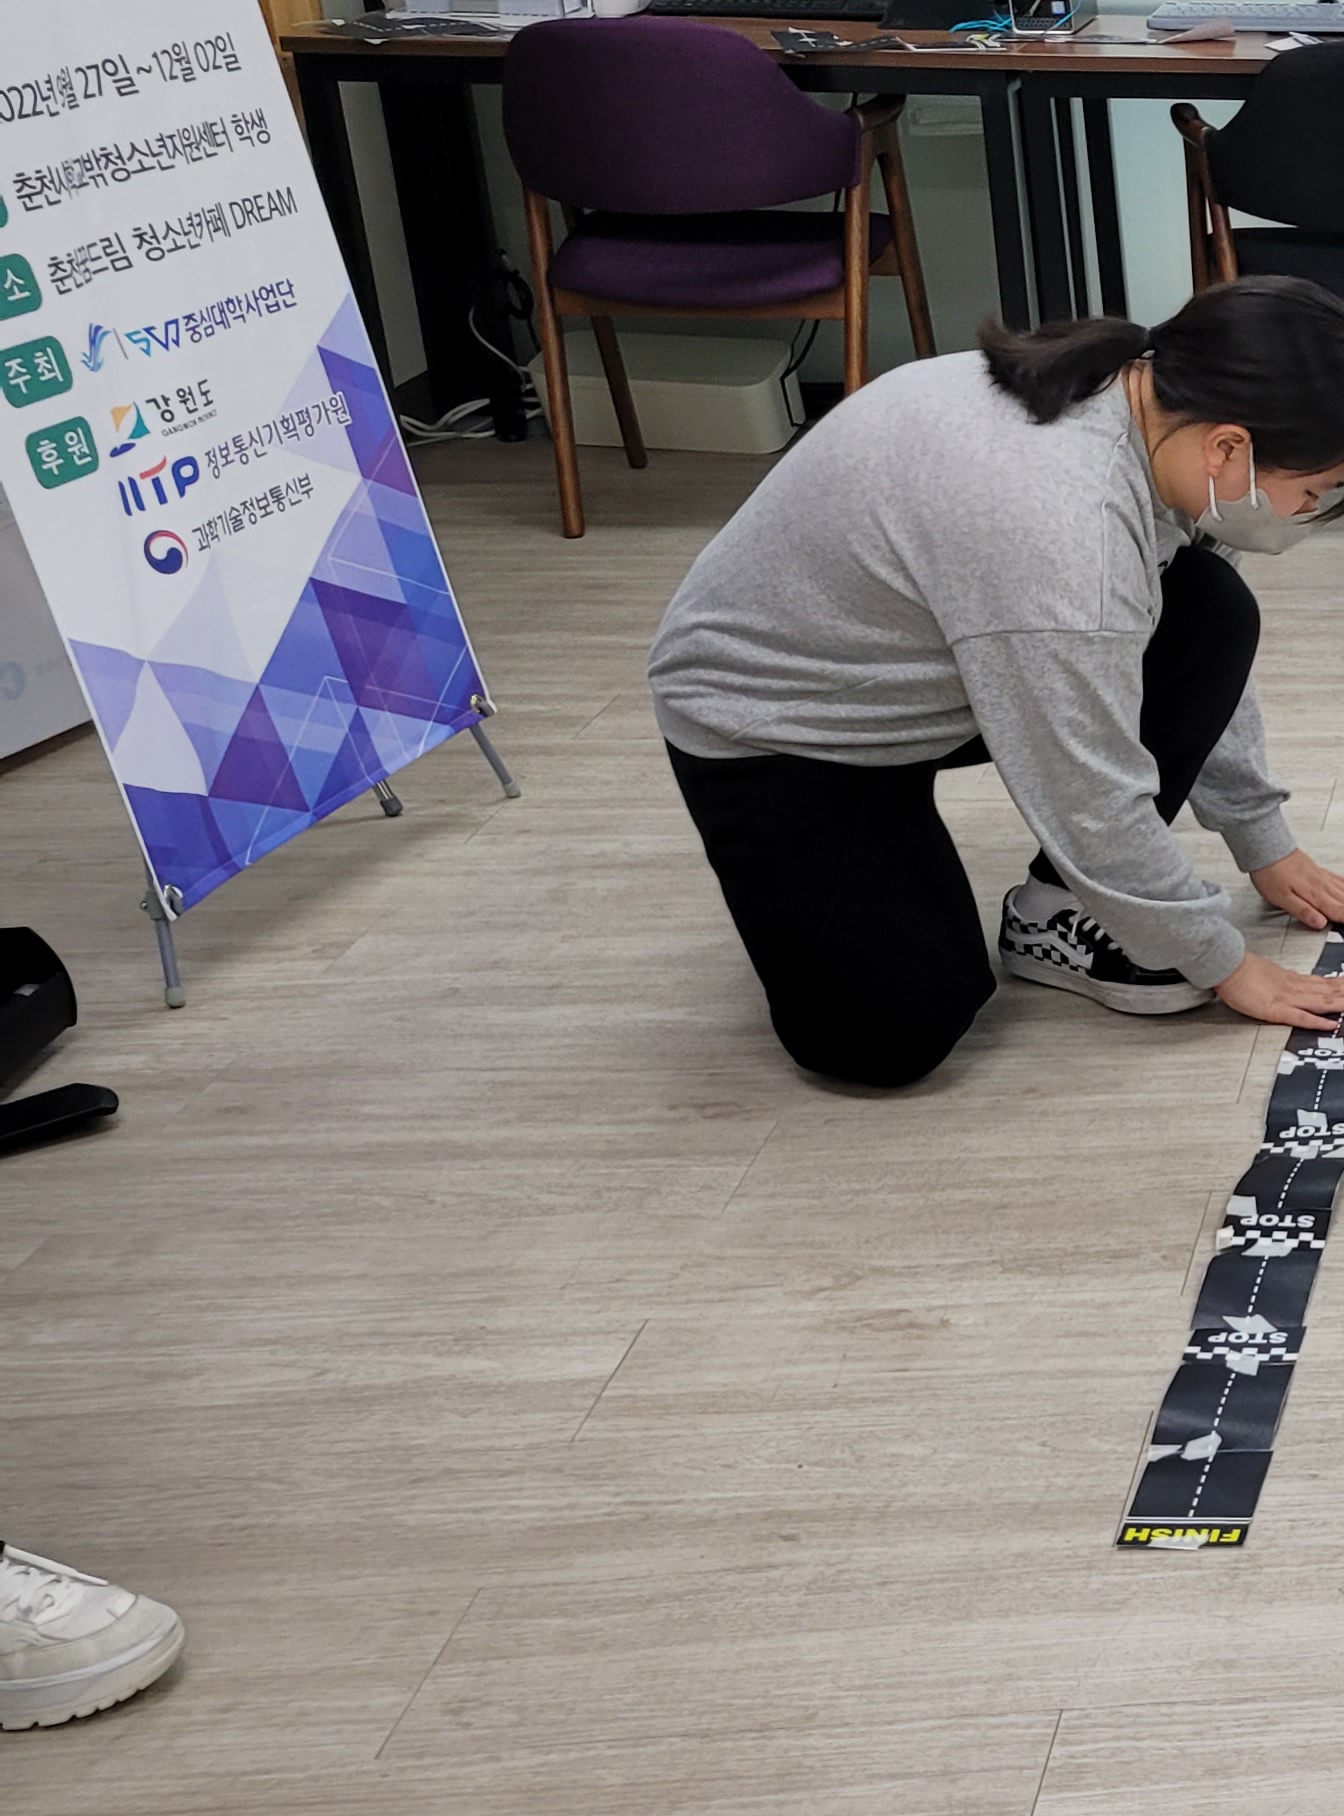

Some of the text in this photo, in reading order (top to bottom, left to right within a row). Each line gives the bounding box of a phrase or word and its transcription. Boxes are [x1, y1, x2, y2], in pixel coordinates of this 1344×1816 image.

[0, 73, 60, 122] 022년
[193, 31, 242, 72] 02일
[230, 107, 271, 147] 학생
[131, 201, 232, 261] 청소년카페
[228, 186, 299, 230] DREAM
[182, 278, 298, 343] 중심대학사업단
[4, 346, 65, 394] 주최
[145, 378, 215, 423] 강원도
[36, 427, 93, 475] 후원
[204, 393, 352, 480] 정보통신기획평가원
[191, 473, 315, 552] 과학기술정보통신부
[1240, 1213, 1316, 1228] STOP
[1207, 1331, 1289, 1345] STOP
[1122, 1527, 1242, 1543] FINISH
